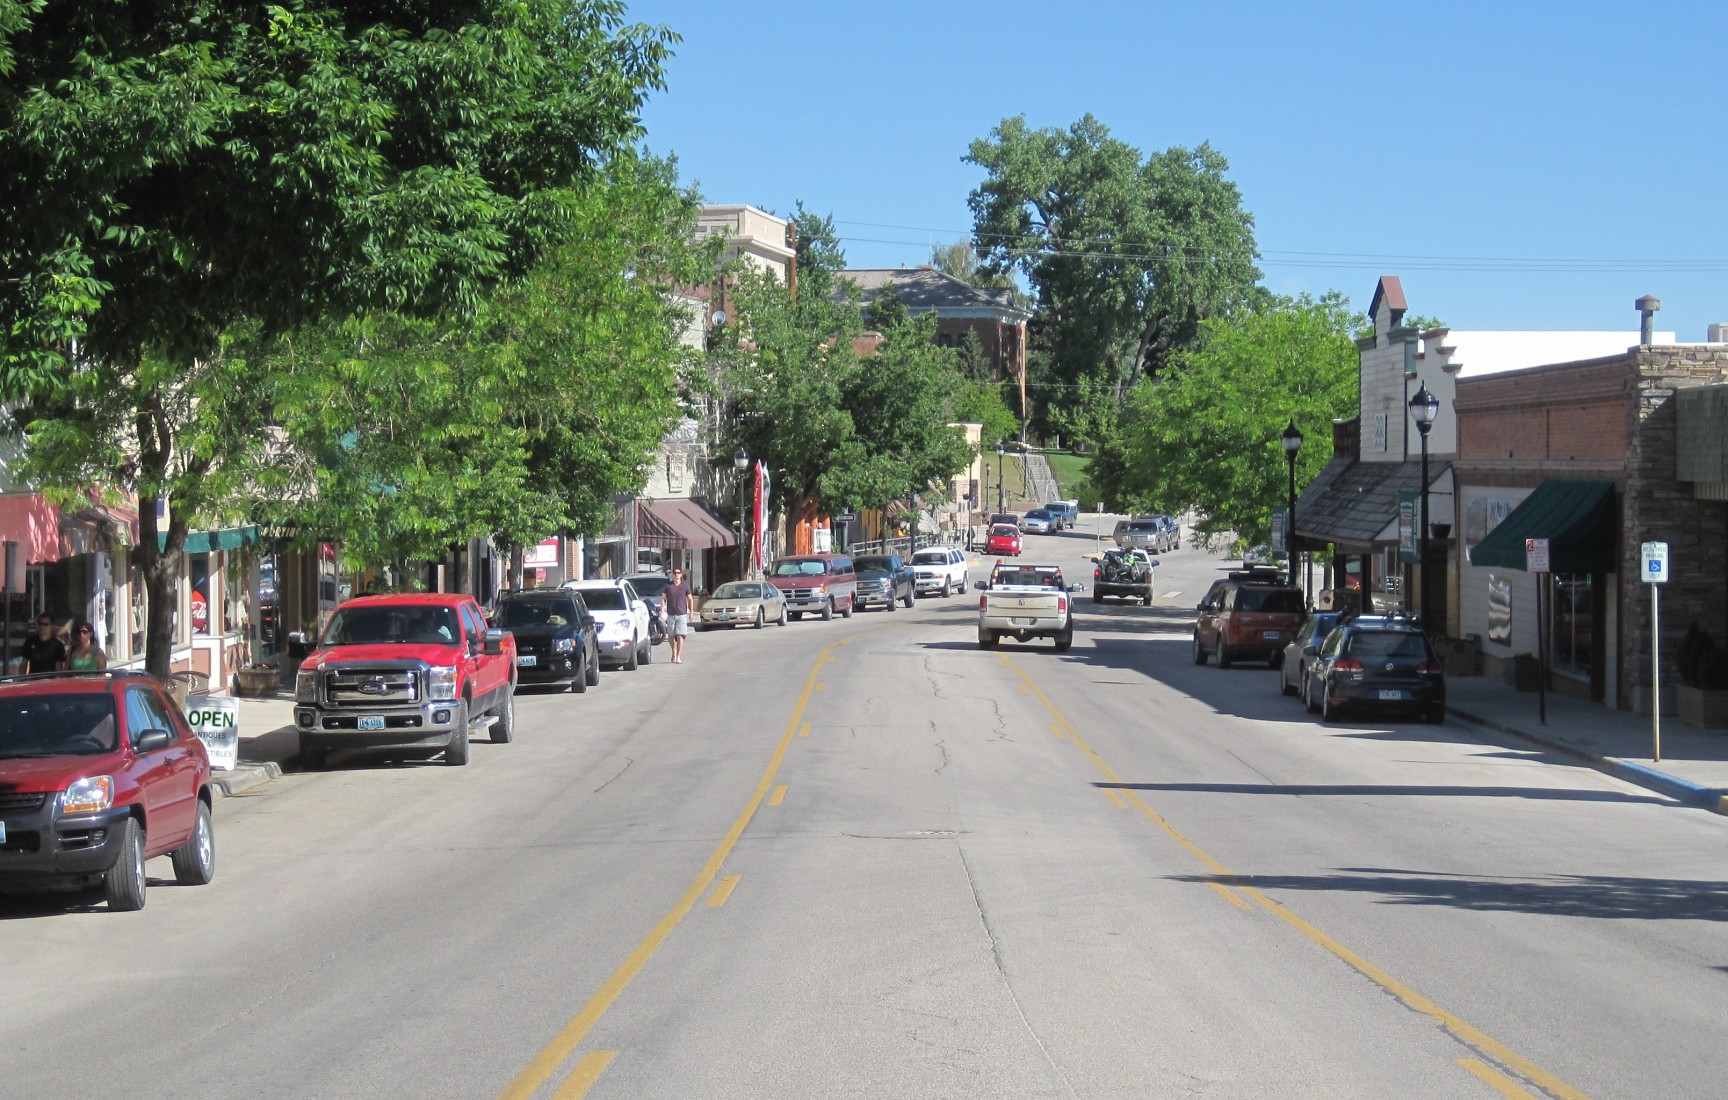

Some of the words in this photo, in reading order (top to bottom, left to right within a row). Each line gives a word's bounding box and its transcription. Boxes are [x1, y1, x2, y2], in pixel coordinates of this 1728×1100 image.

[261, 526, 302, 538] PORTING
[188, 710, 234, 728] OPEN
[206, 740, 212, 748] &
